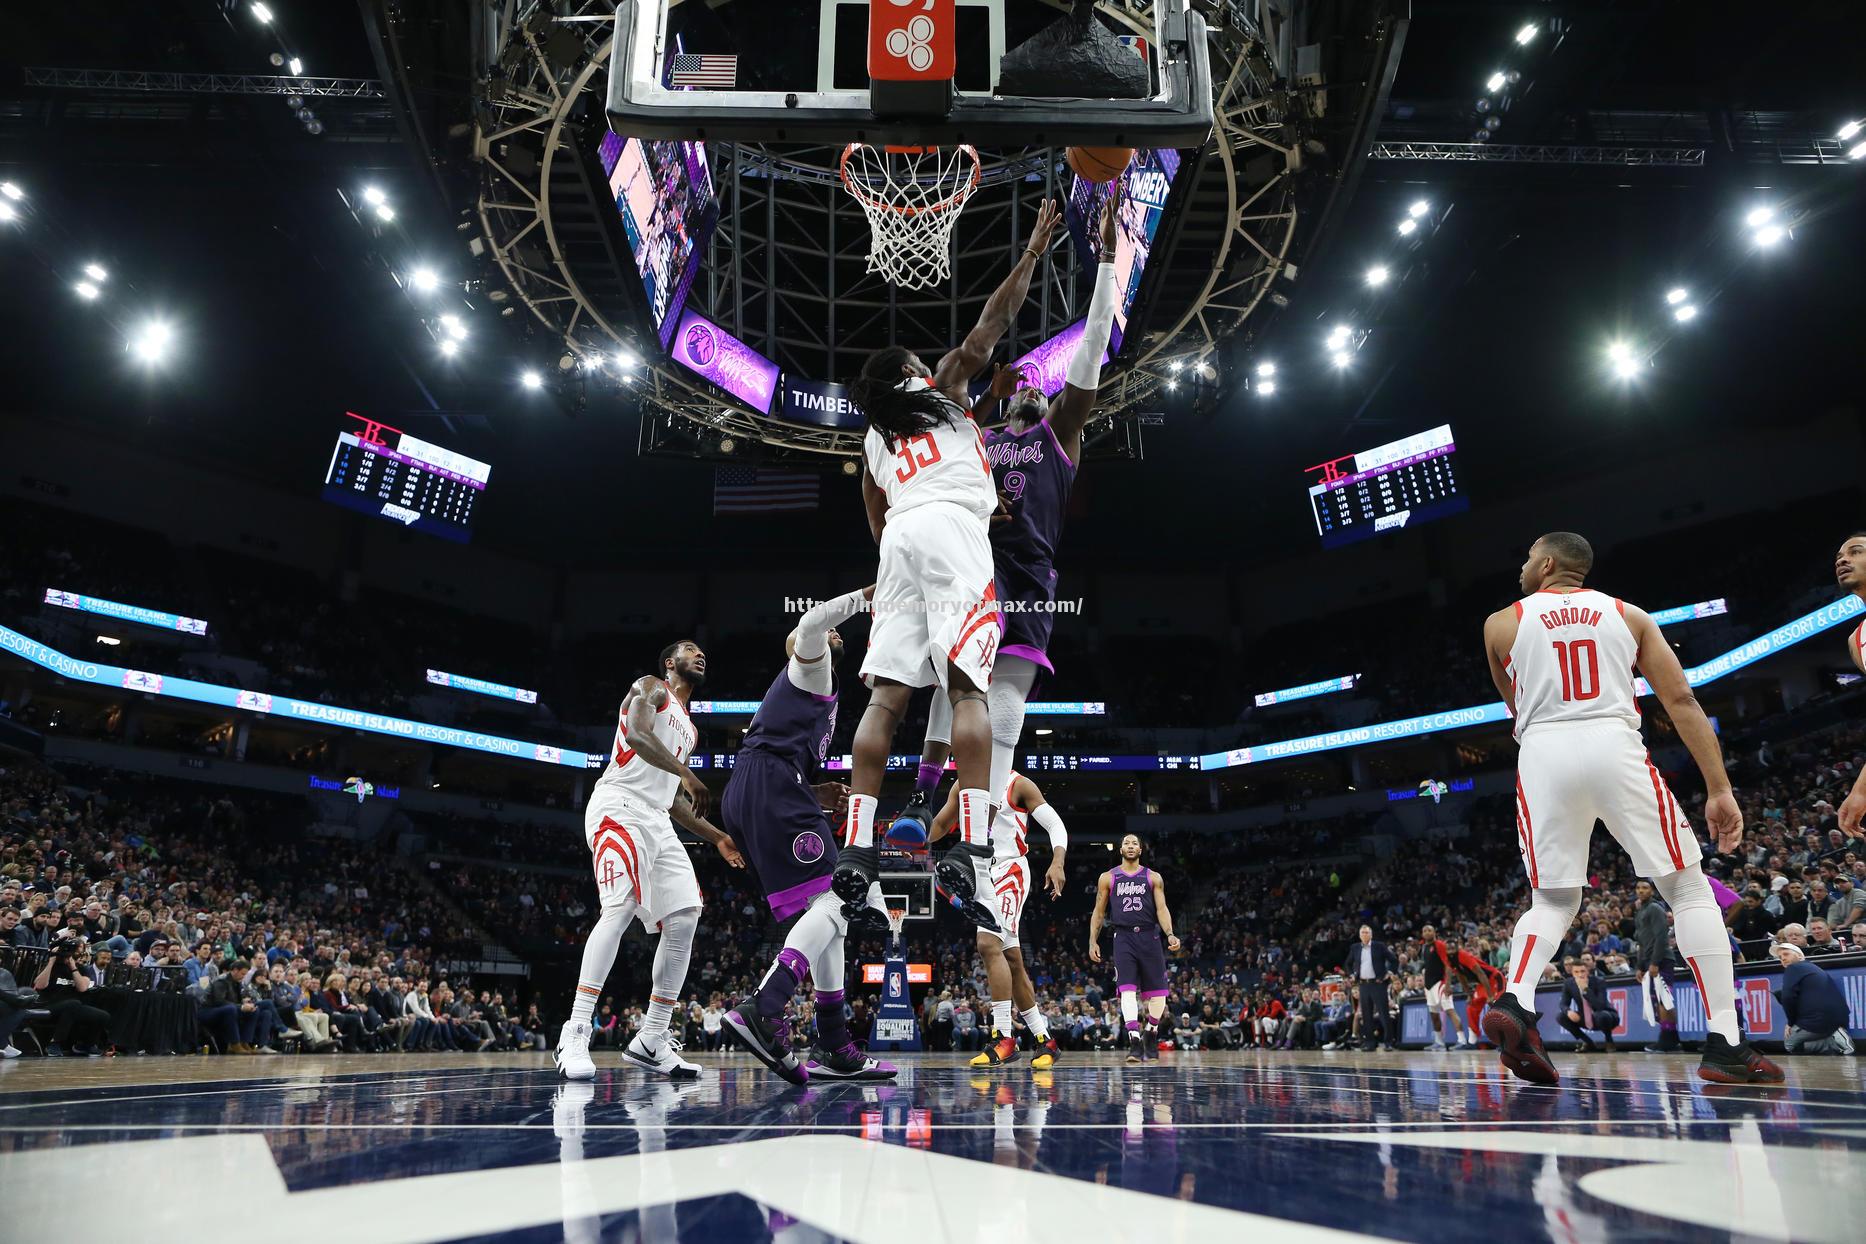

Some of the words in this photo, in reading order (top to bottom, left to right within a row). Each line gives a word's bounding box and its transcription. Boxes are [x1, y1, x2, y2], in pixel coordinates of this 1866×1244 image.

[986, 441, 1043, 468] Wolves
[1004, 470, 1026, 500] 9
[85, 598, 133, 613] TREASURE
[1540, 607, 1602, 630] GORDON
[1731, 639, 1770, 667] ISLAND
[1772, 618, 1814, 647] RESORT
[1817, 613, 1829, 626] &
[38, 648, 47, 662] &
[49, 653, 97, 678] CASINO
[1553, 639, 1600, 701] 10
[454, 676, 486, 688] TREASURE
[290, 702, 364, 725] TREASURE
[365, 716, 413, 734] ISLAND
[416, 725, 463, 743] RESORT
[464, 734, 474, 745] &
[476, 736, 519, 753] CASINO
[1264, 737, 1324, 756] TREASURE
[1325, 729, 1370, 746] ISLAND
[1374, 720, 1420, 738] RESORT
[1423, 718, 1432, 730] &
[1435, 709, 1485, 727] CASINO
[310, 775, 341, 790] Treasure
[376, 785, 399, 799] Island
[1387, 789, 1416, 800] Treasure
[1451, 778, 1472, 792] Island
[1117, 882, 1146, 896] Wolves
[1123, 897, 1143, 912] 25
[1751, 989, 1767, 1023] TV
